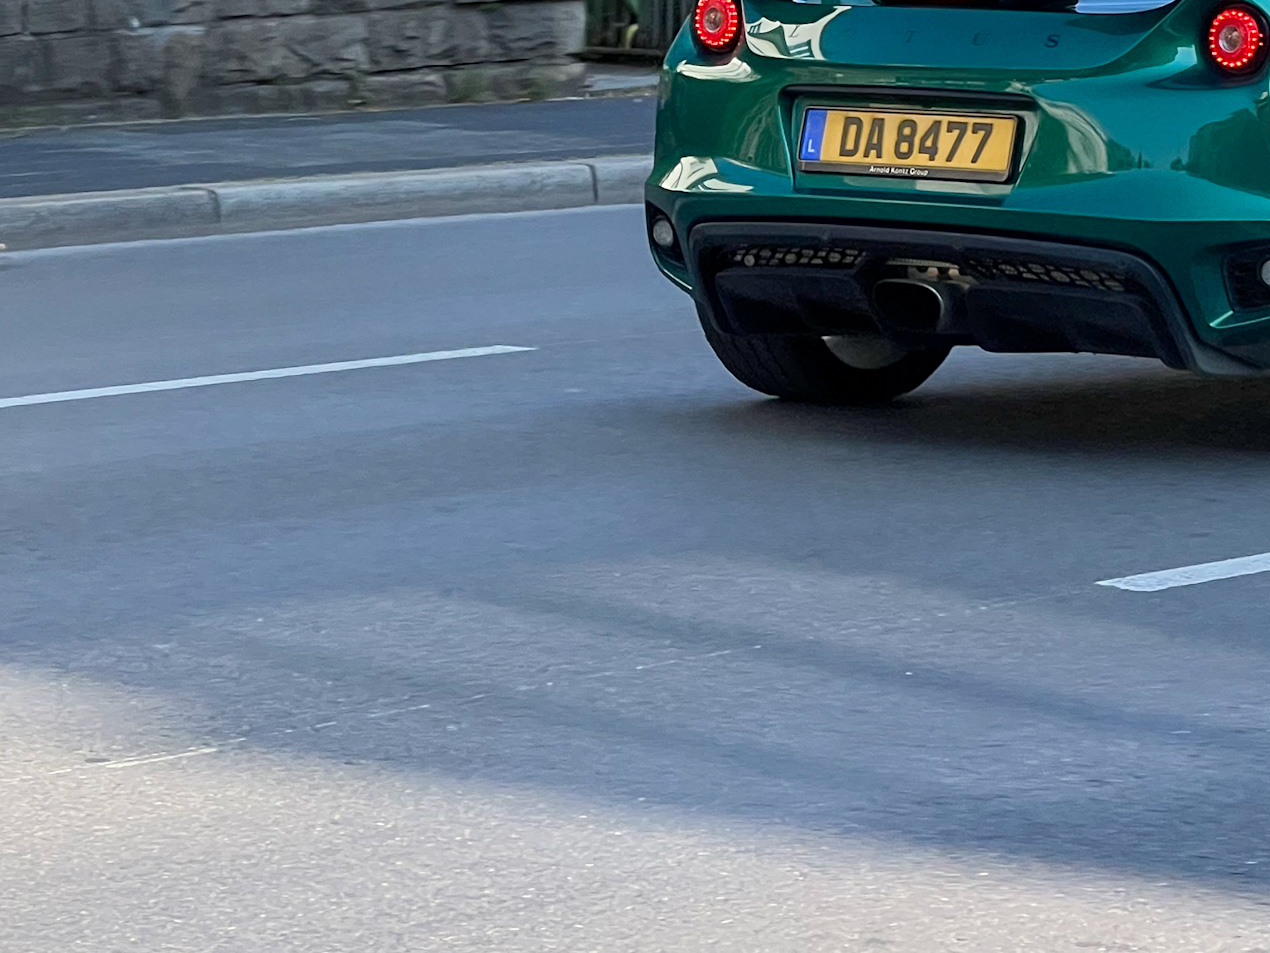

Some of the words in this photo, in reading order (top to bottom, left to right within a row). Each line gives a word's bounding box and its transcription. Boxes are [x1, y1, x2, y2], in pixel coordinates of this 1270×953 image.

[788, 25, 1061, 49] LTUS
[807, 138, 815, 153] L
[839, 116, 885, 159] DA
[894, 118, 994, 164] 8477
[869, 165, 890, 174] Arnold
[910, 167, 929, 176] Group
